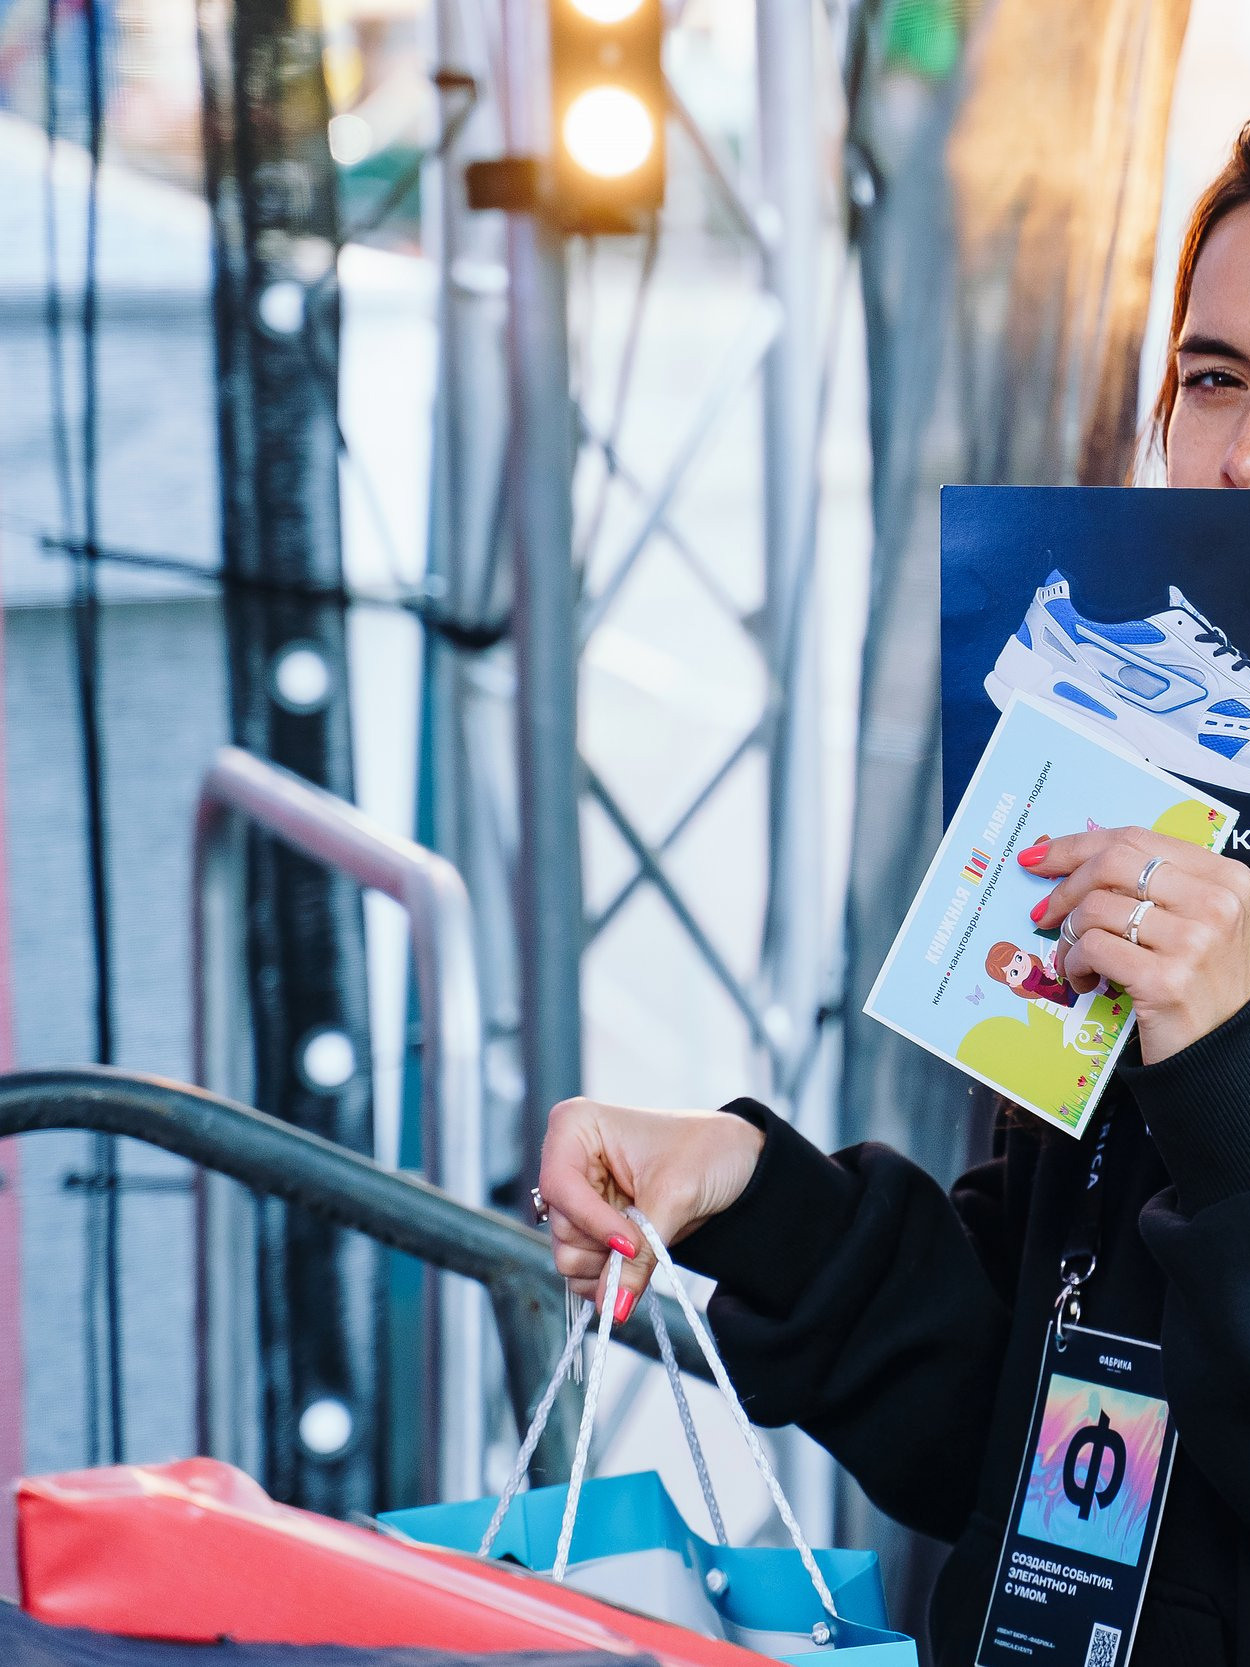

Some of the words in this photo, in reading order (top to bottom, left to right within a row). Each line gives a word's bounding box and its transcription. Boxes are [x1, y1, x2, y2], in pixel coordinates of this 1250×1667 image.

[924, 887, 970, 965] КНИЖНАЯ
[982, 791, 1017, 846] ЛАВКА
[931, 976, 950, 1006] книги
[948, 910, 982, 971] канцтовары
[979, 862, 1004, 907] игрушки
[1003, 808, 1031, 858] сувениры
[1028, 760, 1053, 804] подарки
[1099, 1355, 1132, 1372] ФАБРИКА
[1008, 1567, 1067, 1593] ЭЛЕГАНТНО
[1067, 1584, 1077, 1596] И
[1011, 1551, 1061, 1576] СОЗДАЕМ
[1062, 1566, 1114, 1590] СОБЫТИЯ.
[1005, 1582, 1013, 1594] С
[1013, 1584, 1048, 1604] УМОМ.
